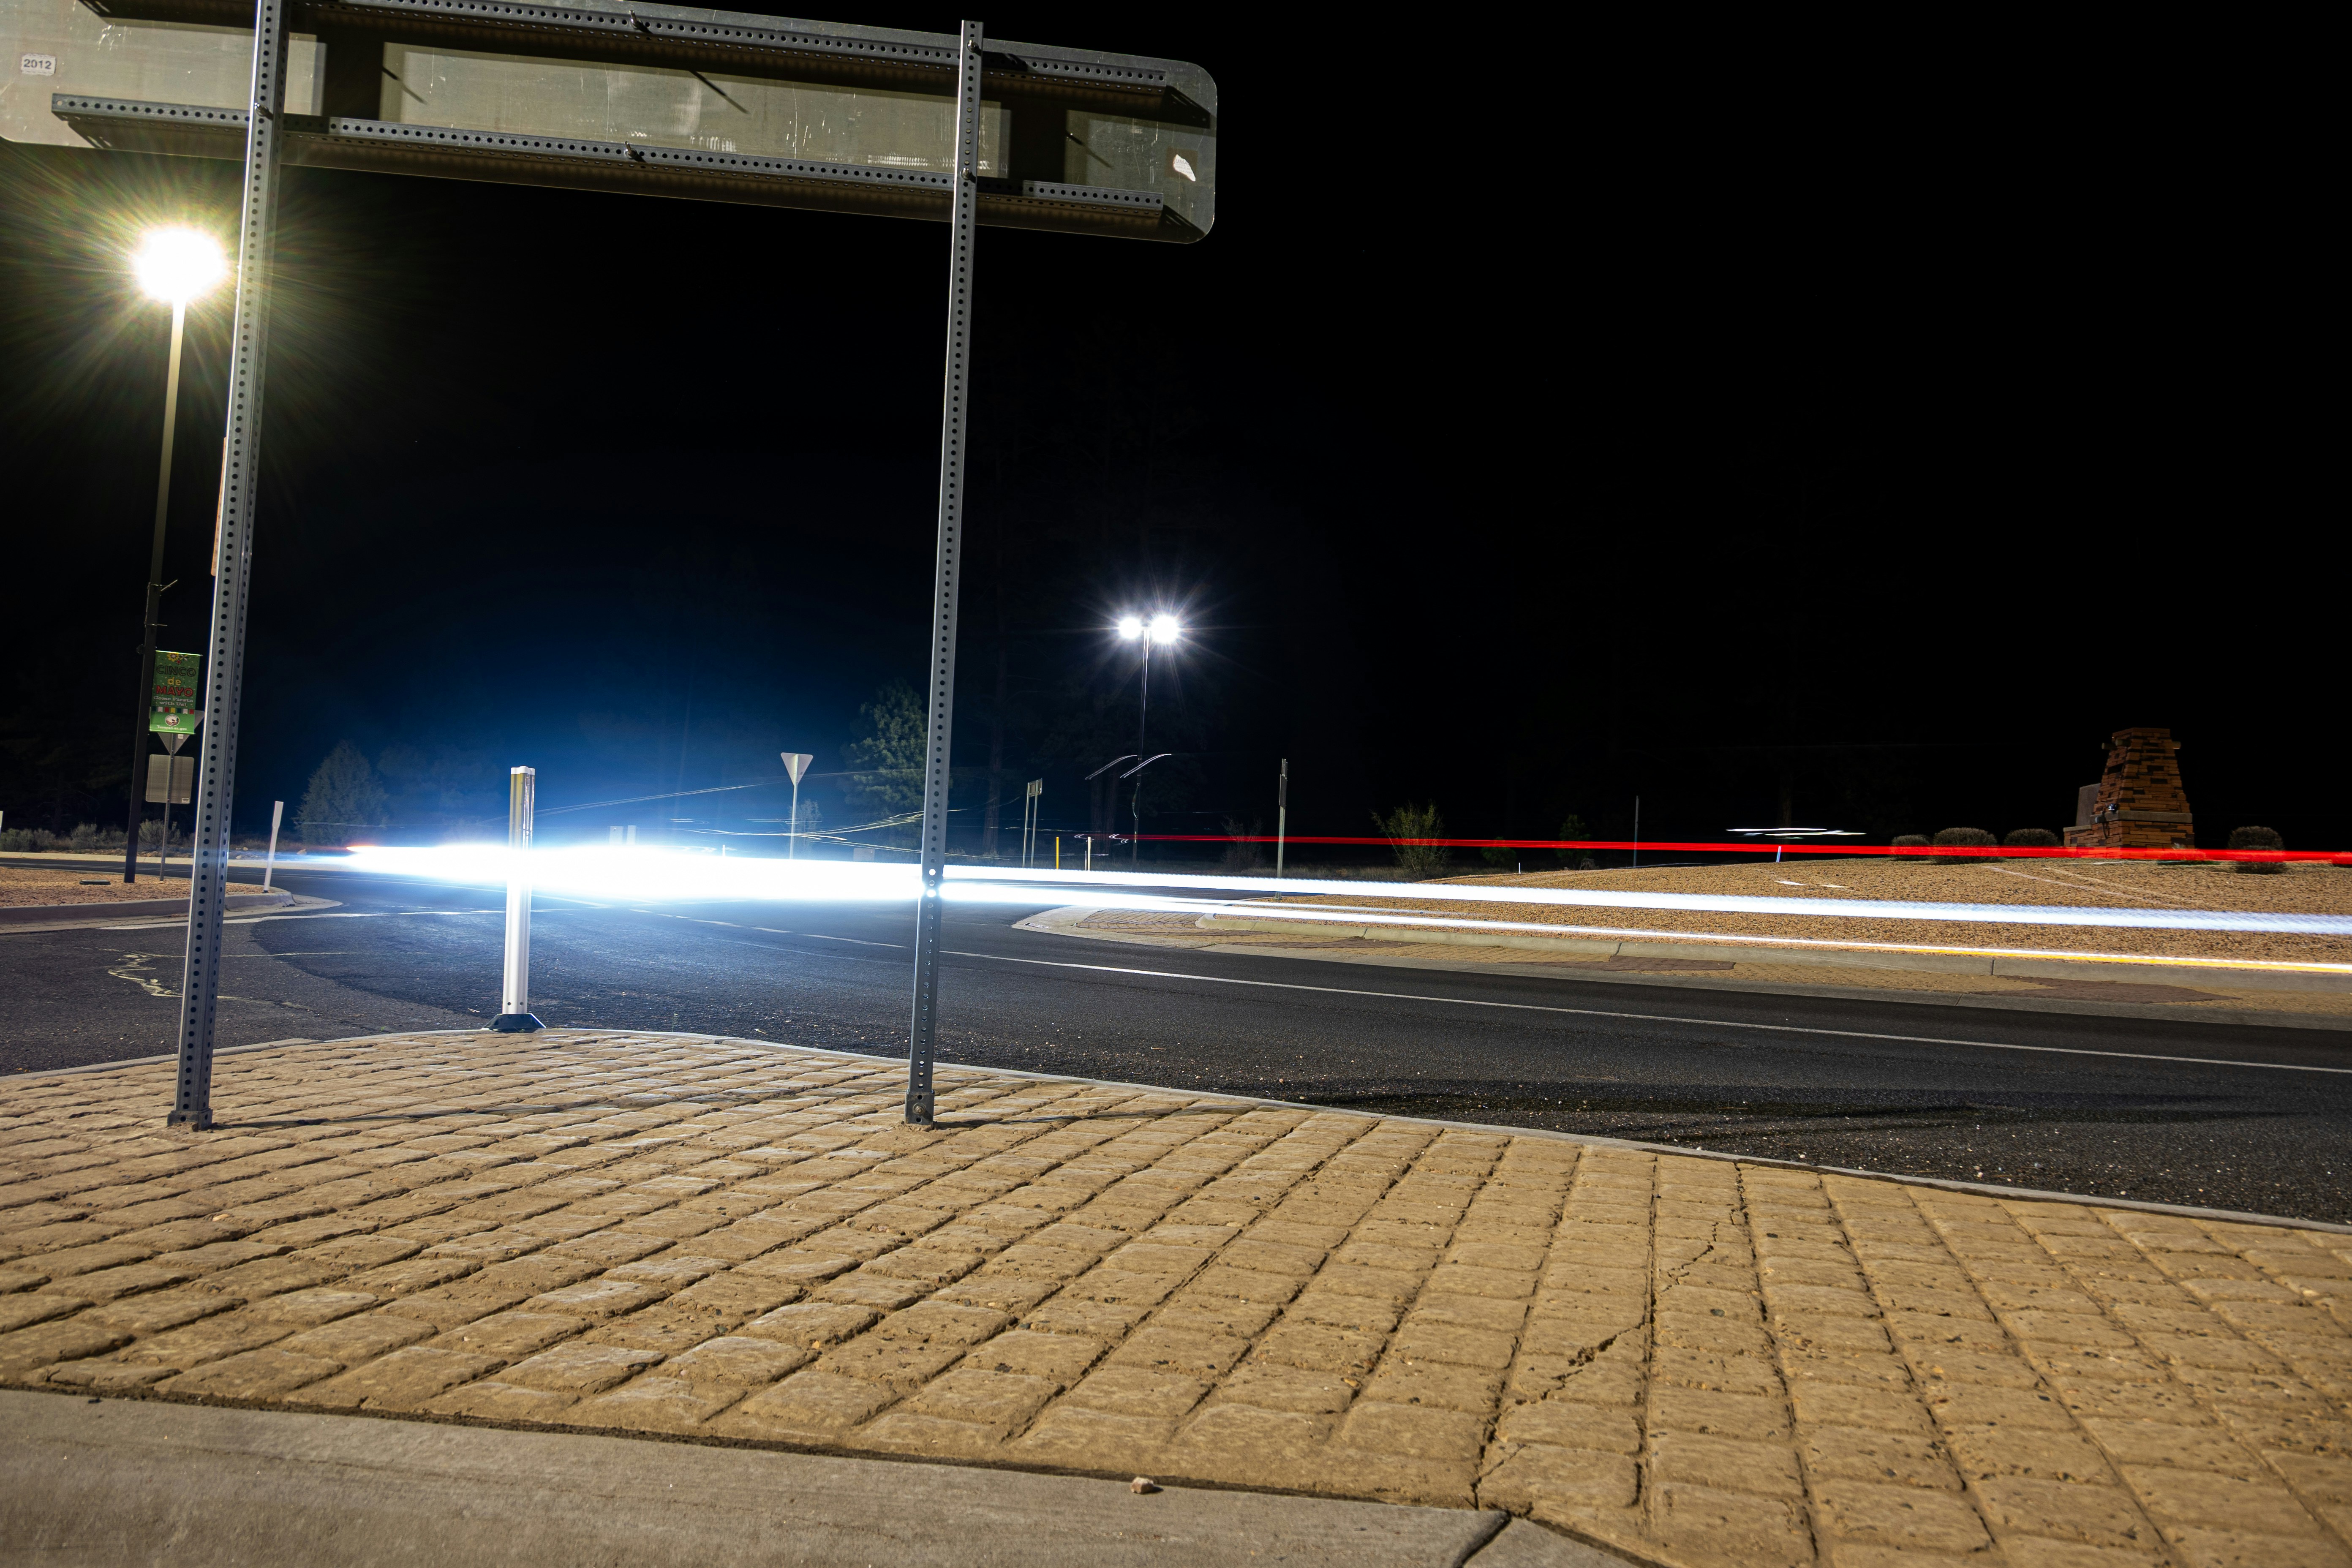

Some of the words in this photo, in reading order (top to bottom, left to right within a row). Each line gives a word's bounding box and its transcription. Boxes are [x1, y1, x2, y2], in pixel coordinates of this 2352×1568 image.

[24, 59, 52, 69] 2012
[157, 665, 196, 677] CINCO
[167, 676, 182, 686] de
[156, 685, 193, 697] MAYO
